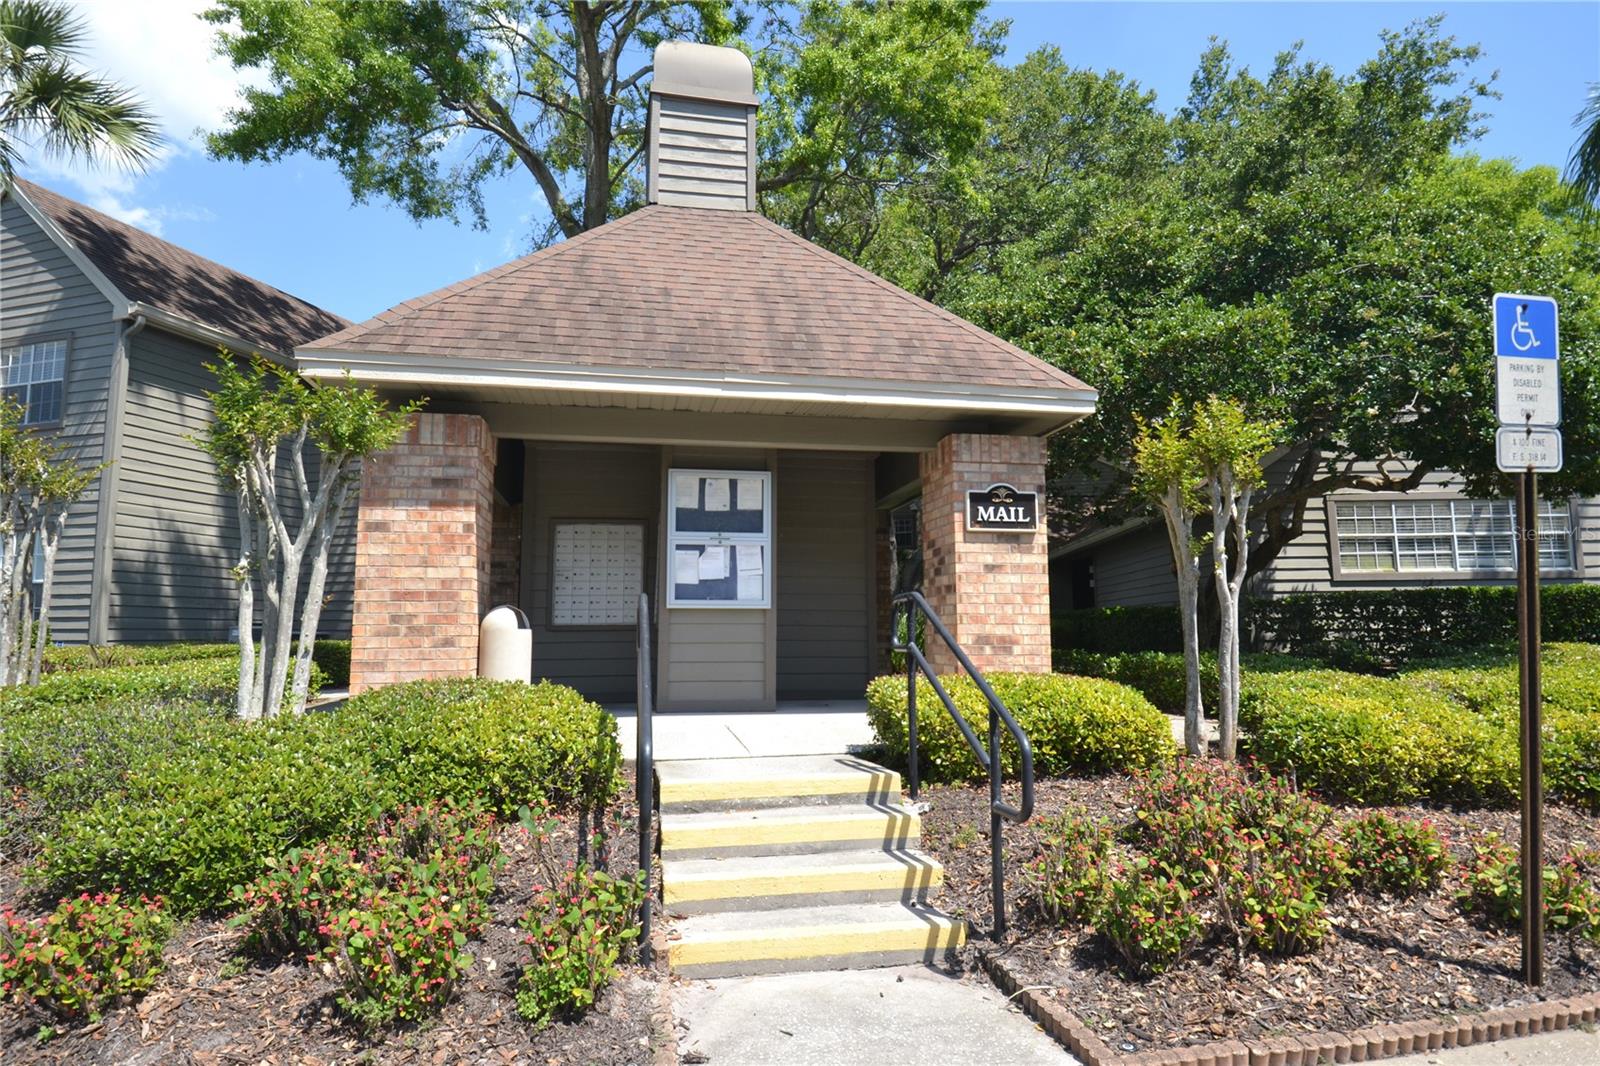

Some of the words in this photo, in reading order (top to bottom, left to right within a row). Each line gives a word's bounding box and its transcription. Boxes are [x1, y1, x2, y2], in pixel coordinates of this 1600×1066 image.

[1509, 363, 1534, 373] PARKING
[1536, 364, 1545, 374] BY
[1513, 378, 1542, 388] DISABLED
[1516, 393, 1538, 402] PERMIT
[1532, 438, 1545, 447] FINE
[977, 505, 1031, 522] MAIL
